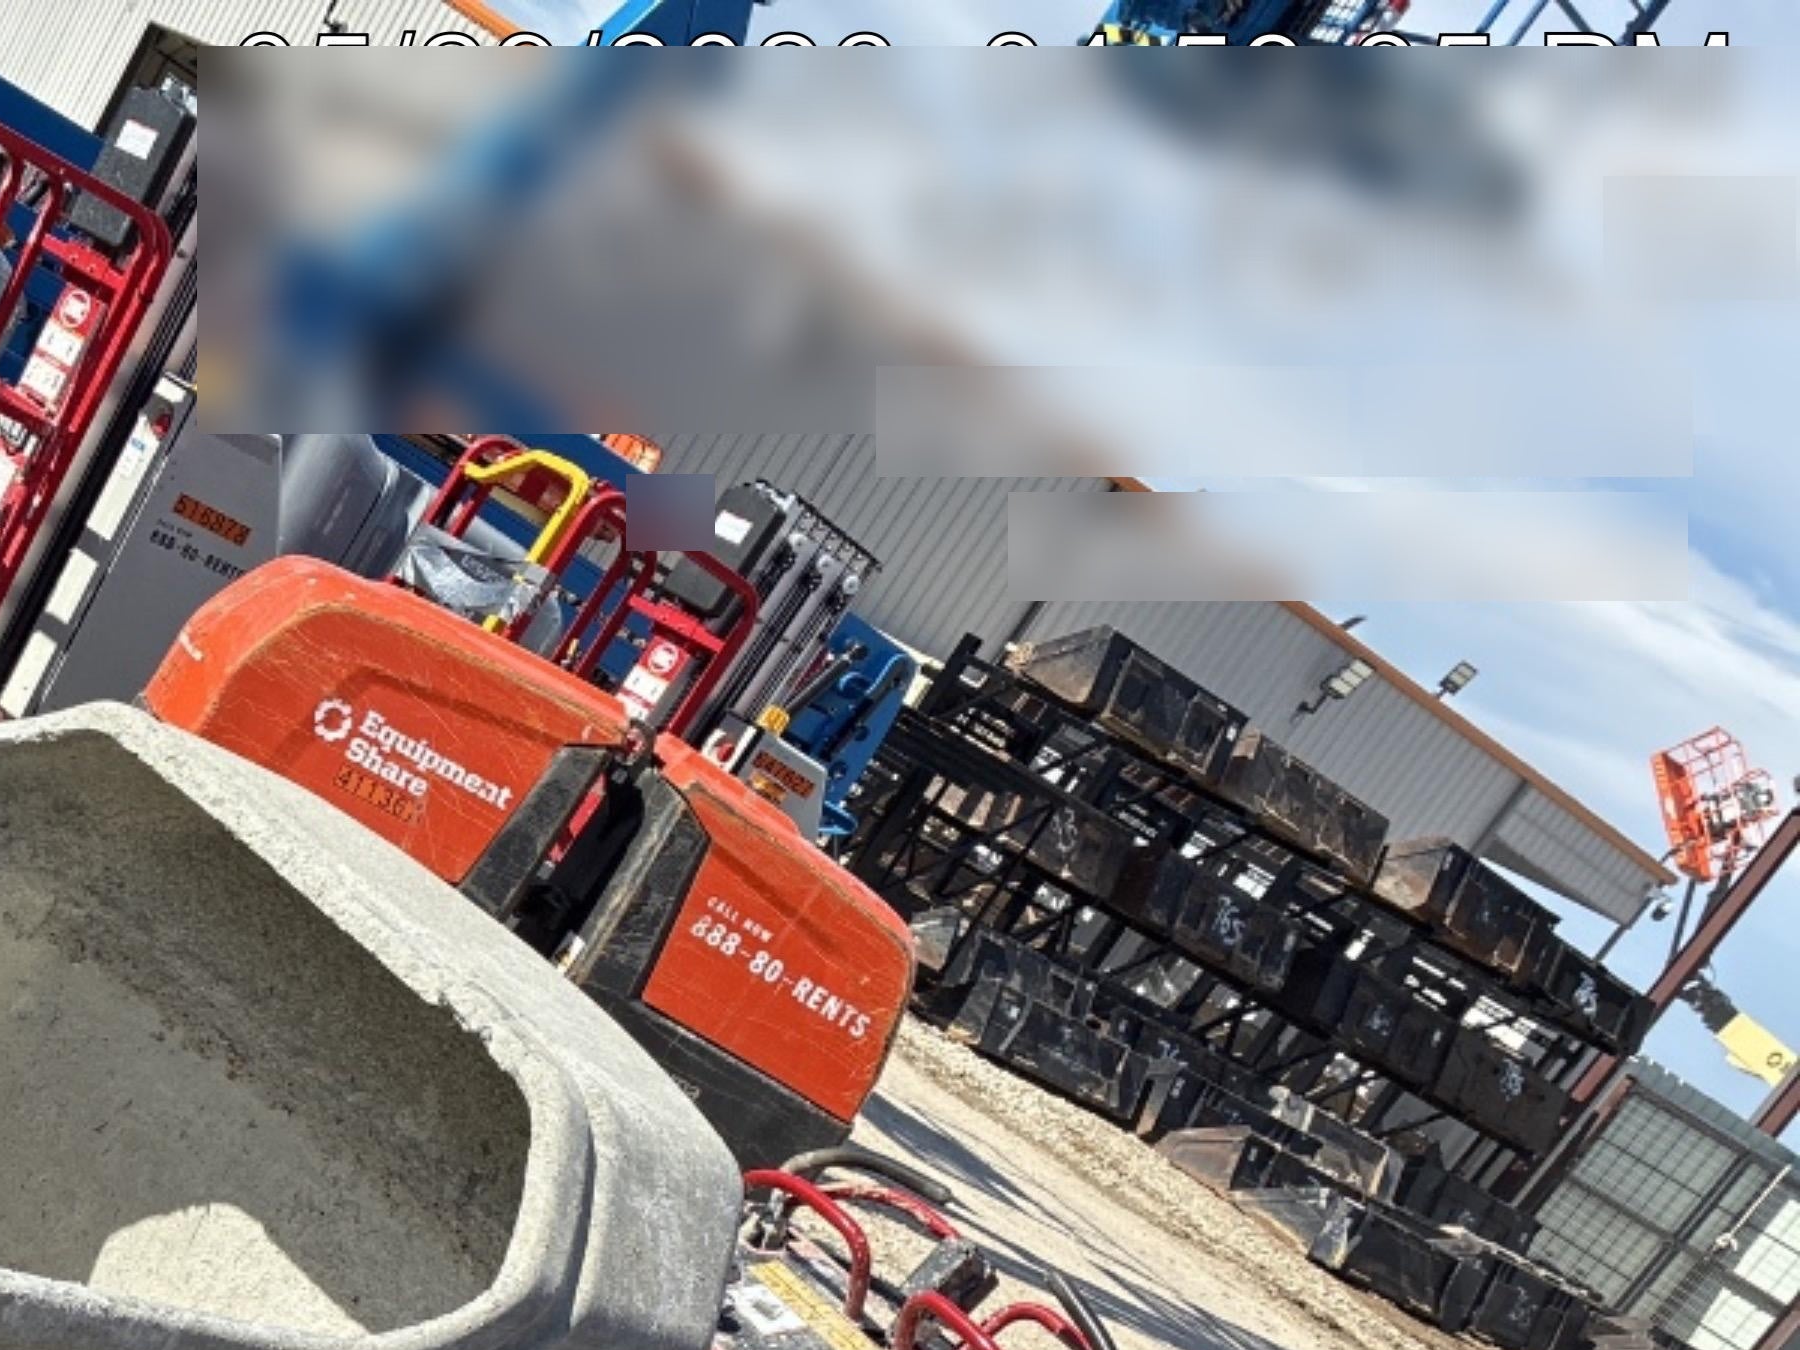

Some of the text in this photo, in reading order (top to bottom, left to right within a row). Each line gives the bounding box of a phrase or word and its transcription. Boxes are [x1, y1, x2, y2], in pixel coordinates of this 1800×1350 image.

[344, 737, 429, 796] Share
[359, 709, 513, 809] Equipment
[707, 896, 738, 923] CALL
[690, 914, 871, 1038] 888-80-RENTS
